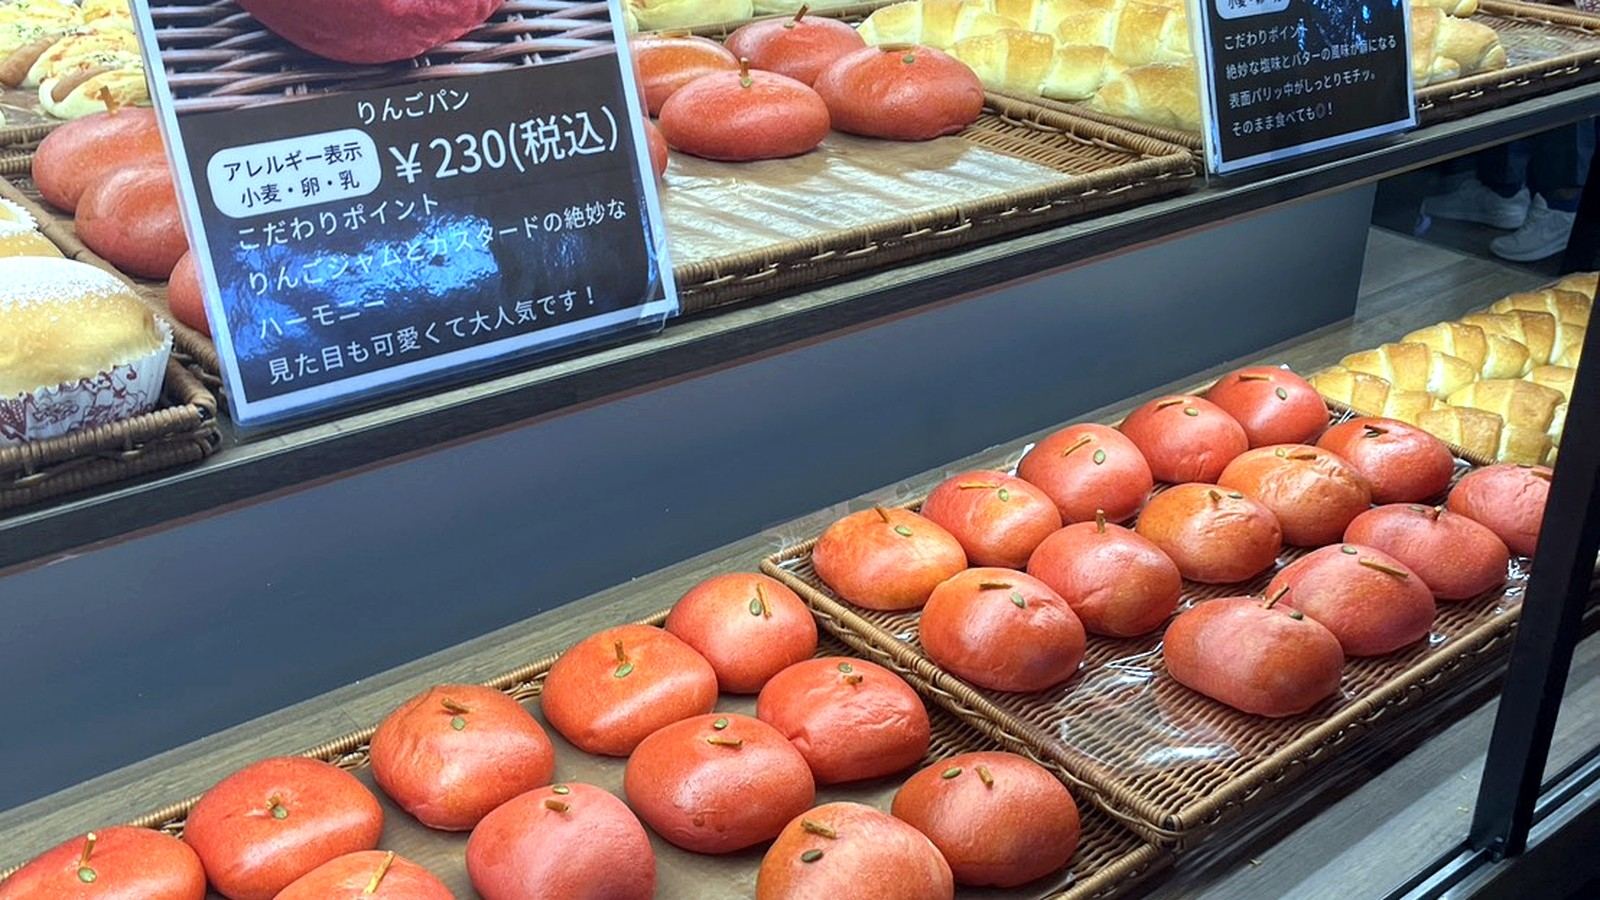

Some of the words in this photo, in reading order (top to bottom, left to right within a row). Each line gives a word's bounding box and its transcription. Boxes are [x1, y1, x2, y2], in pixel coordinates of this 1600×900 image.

[1224, 23, 1308, 50] こだわりポイント
[358, 88, 470, 125] りんごパン
[223, 141, 363, 182] アレルギー表示
[241, 169, 361, 209] 小麦・卵・乳
[238, 193, 438, 250] こだわりポイント
[249, 198, 627, 296] りんごジャムとカスタードの絶妙な
[260, 299, 385, 340] ハーモニー
[269, 286, 594, 385] 見た目も可愛くて大人気です！
